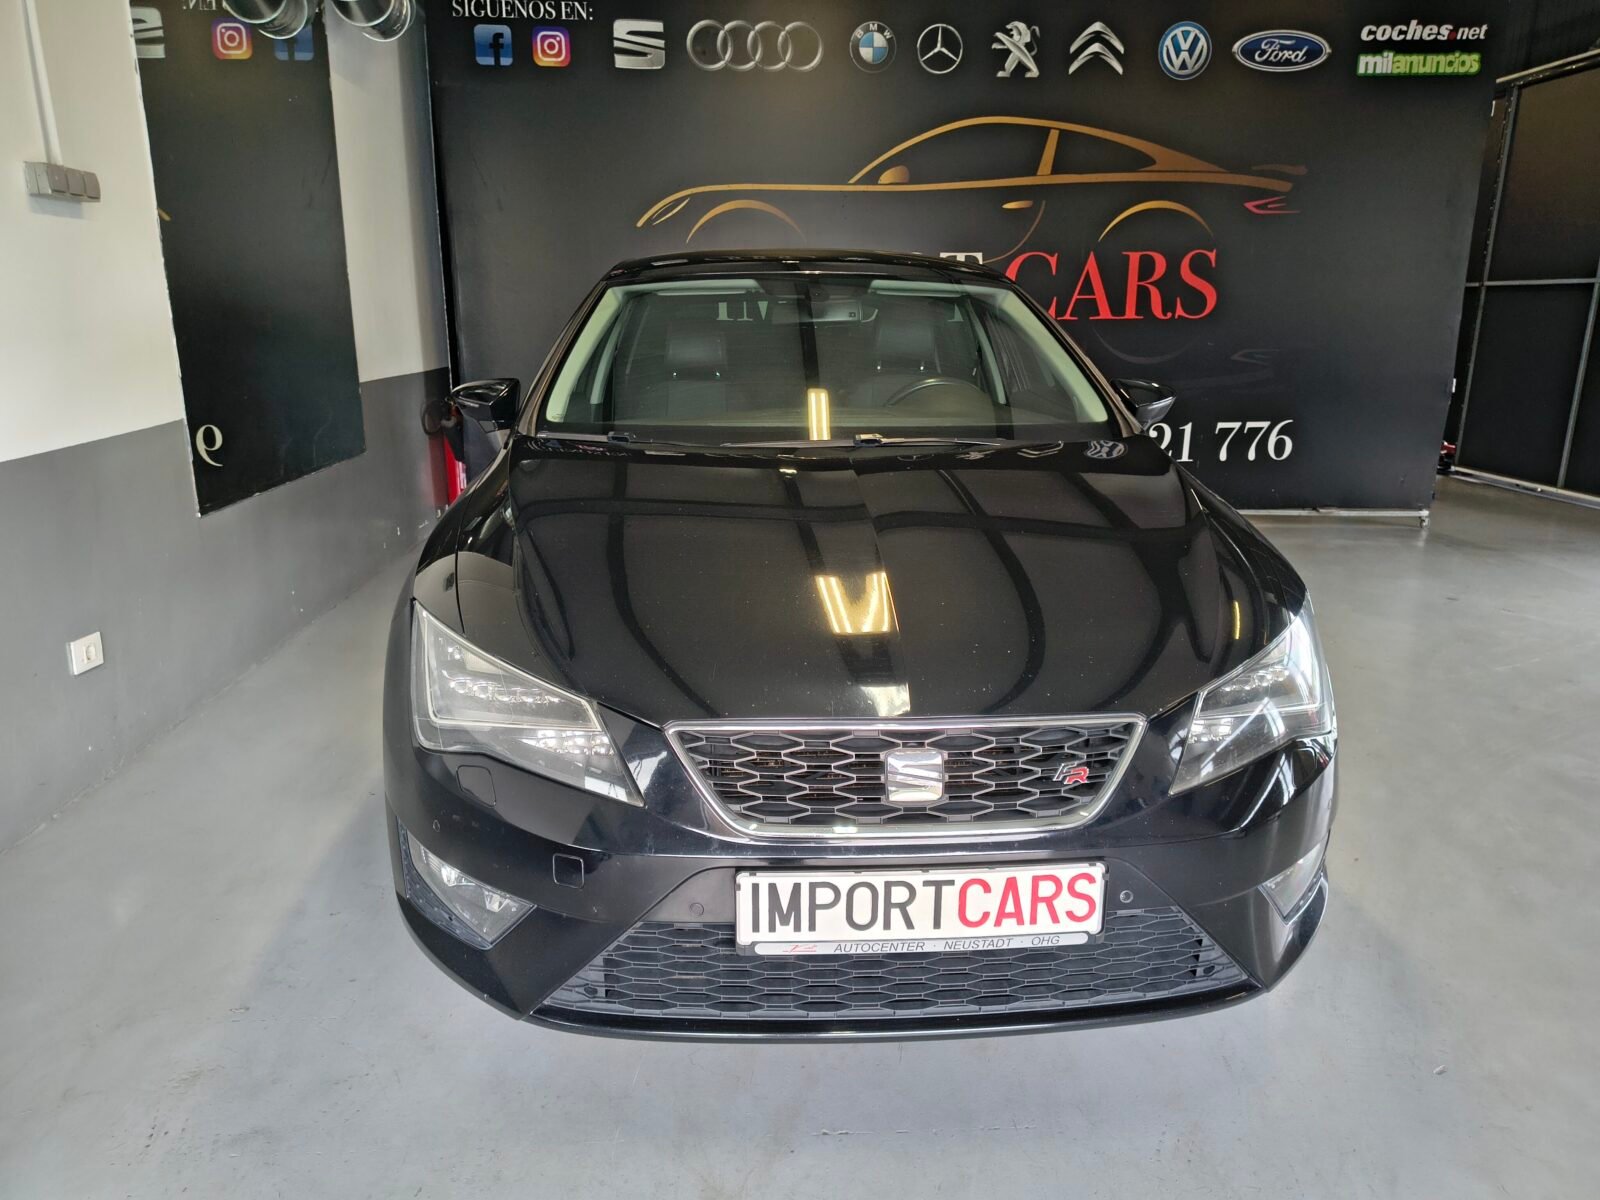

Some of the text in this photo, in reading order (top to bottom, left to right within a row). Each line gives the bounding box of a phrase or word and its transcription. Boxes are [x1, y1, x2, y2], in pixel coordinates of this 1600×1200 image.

[561, 1, 593, 21] EN:
[1360, 19, 1488, 41] coches.net
[1254, 38, 1308, 62] Ford
[1358, 51, 1482, 75] milanuncios
[1005, 249, 1217, 320] CARS
[1215, 419, 1294, 462] 776
[1052, 762, 1090, 785] FR
[833, 941, 925, 954] AUTOCENTER
[943, 937, 1014, 951] NEUSTADT
[1031, 934, 1061, 946] OHG
